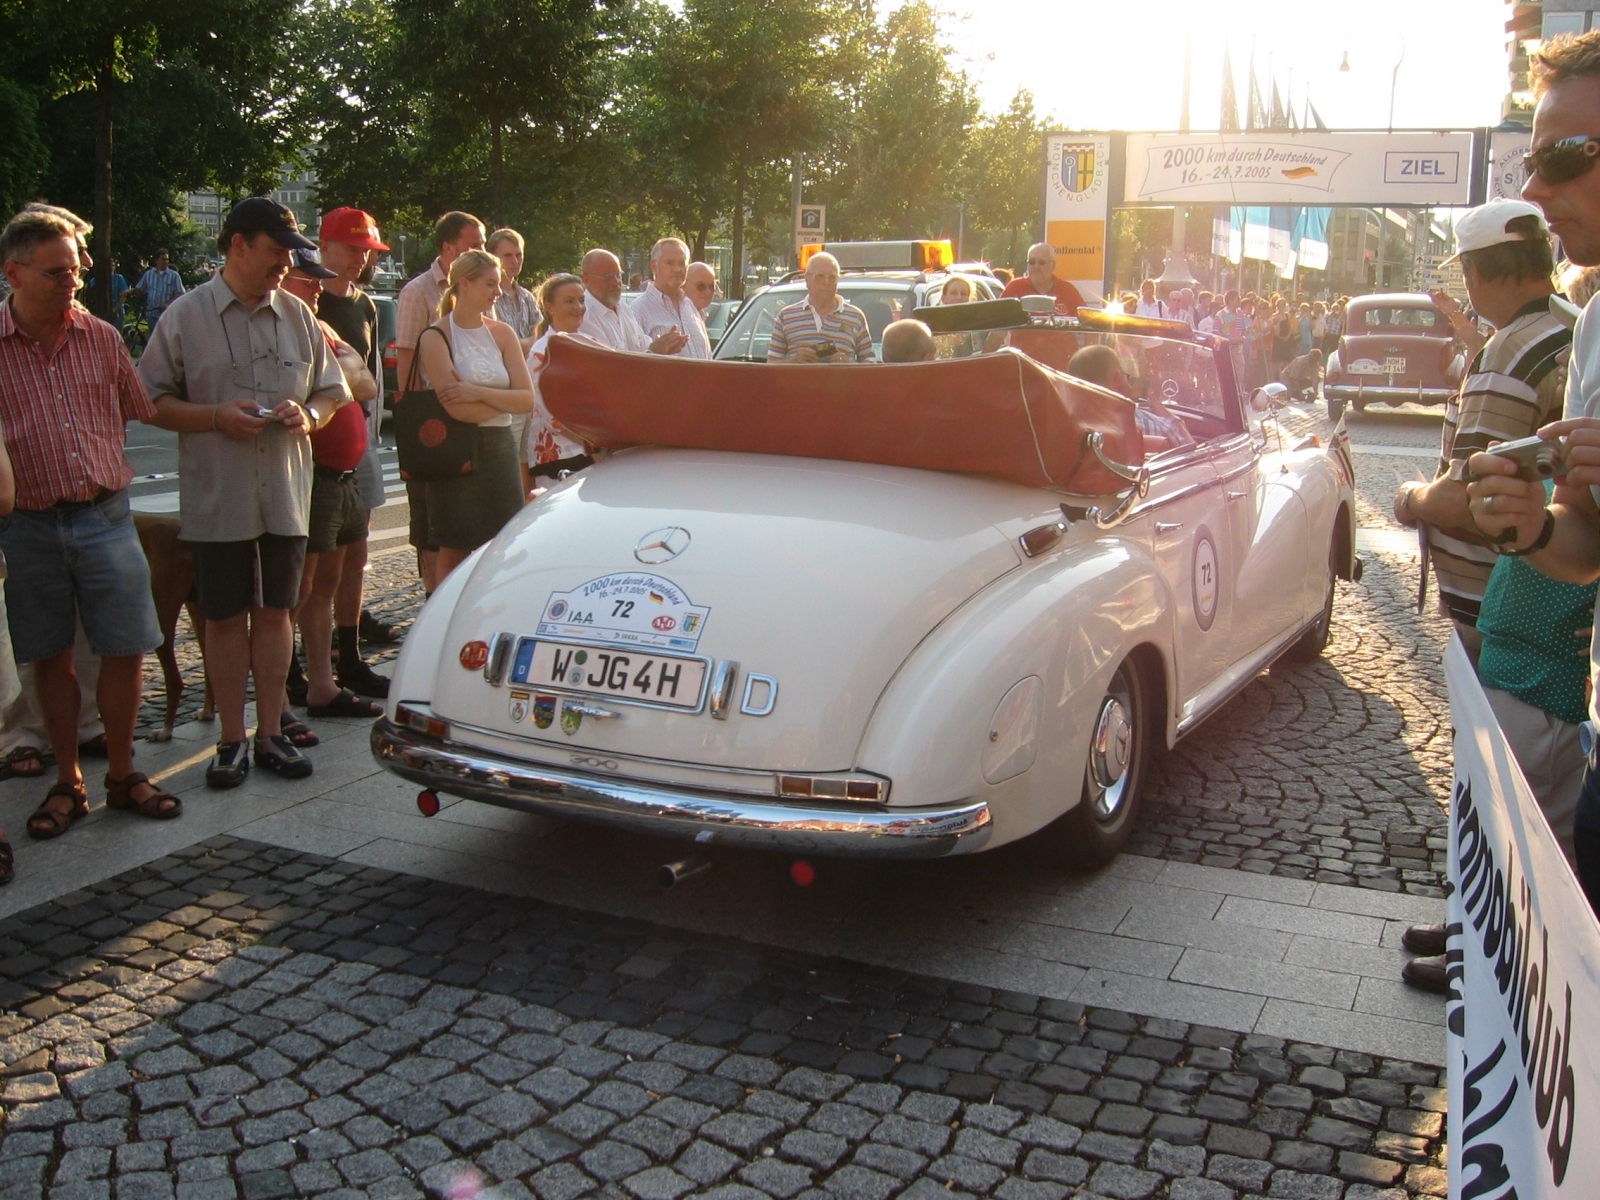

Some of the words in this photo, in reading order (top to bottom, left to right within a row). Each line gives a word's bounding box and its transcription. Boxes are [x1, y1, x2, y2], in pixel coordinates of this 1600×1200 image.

[1163, 148, 1203, 169] 2000
[1206, 147, 1226, 163] km
[1228, 147, 1262, 163] durch
[1264, 148, 1328, 166] Deutschland
[1401, 159, 1445, 175] ZIEL
[1504, 173, 1513, 184] S
[807, 215, 815, 226] P
[1053, 246, 1095, 254] ontinental
[1202, 562, 1211, 586] 72
[583, 578, 609, 597] 2000
[621, 576, 644, 586] durch
[643, 577, 683, 606] Deutschland
[567, 610, 594, 624] IAA
[611, 600, 635, 618] 72
[518, 665, 526, 675] D
[551, 648, 573, 682] W
[740, 672, 779, 716] D
[569, 753, 619, 770] 300
